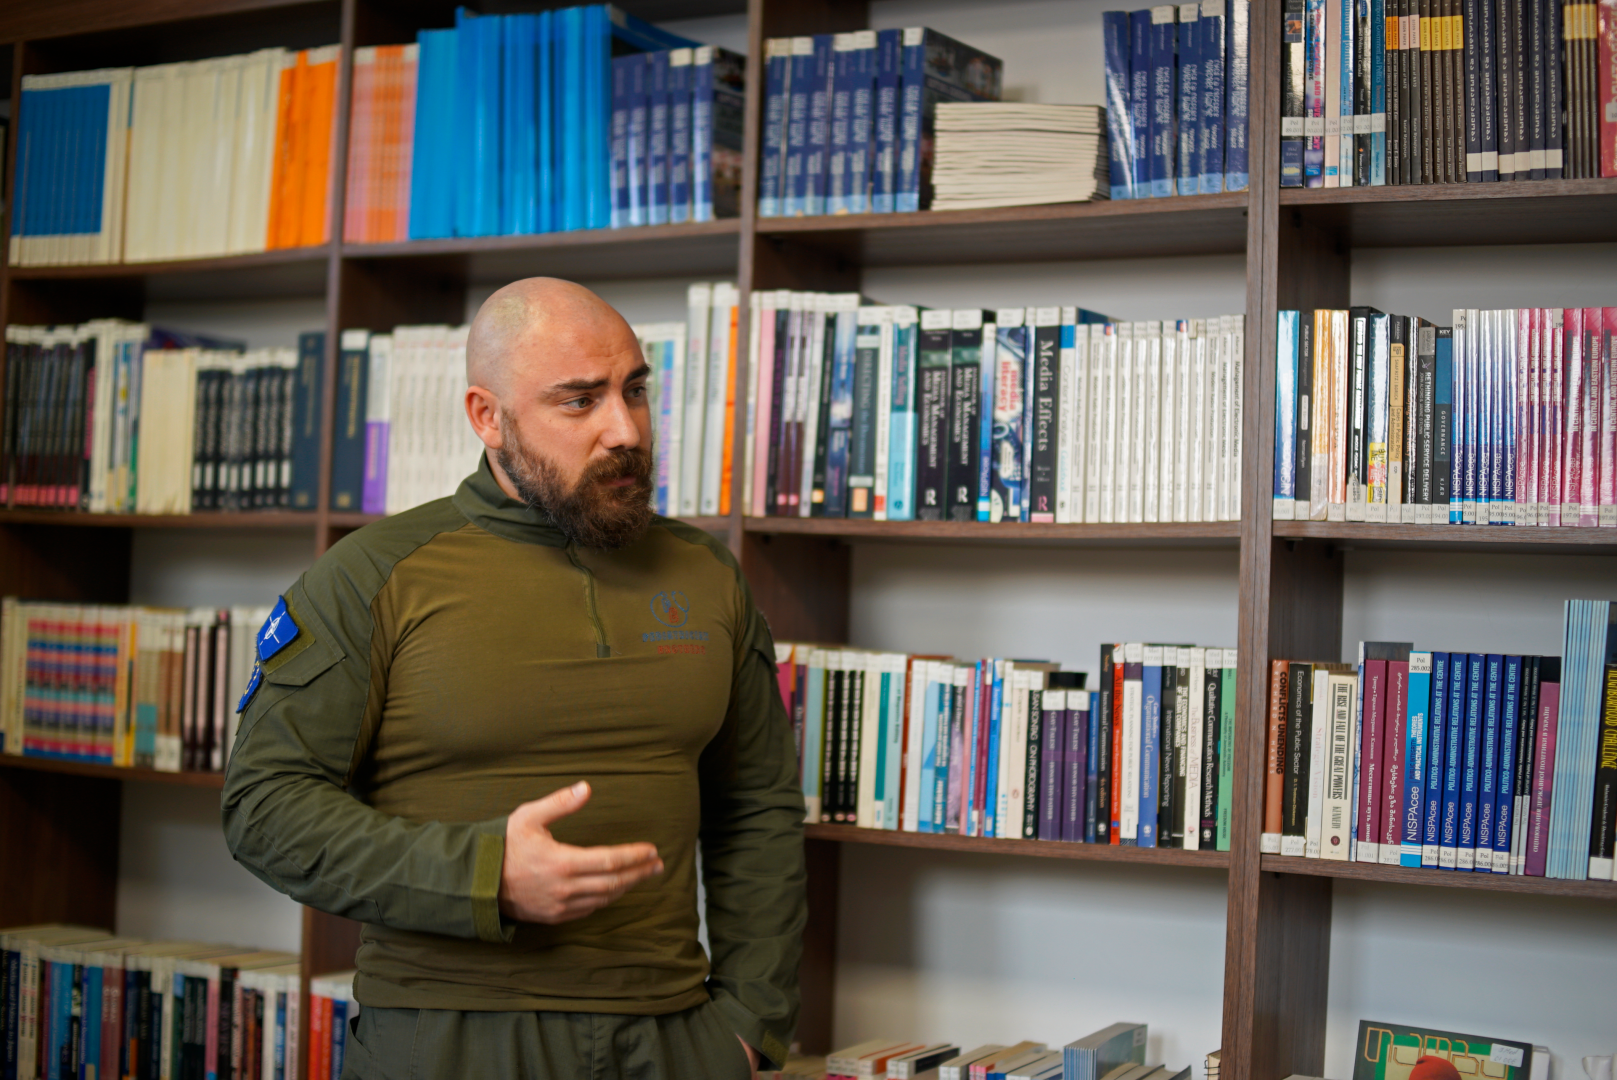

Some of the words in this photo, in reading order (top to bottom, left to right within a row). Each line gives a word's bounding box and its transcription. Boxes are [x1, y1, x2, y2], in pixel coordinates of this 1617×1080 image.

[860, 350, 872, 408] DIRECTING
[932, 371, 941, 401] MEDIA
[1039, 341, 1054, 391] Media
[1062, 365, 1071, 405] Content
[895, 377, 907, 405] Selling
[998, 361, 1010, 412] literacy
[1010, 370, 1019, 410] media
[922, 393, 932, 446] ECONOMICS
[954, 390, 963, 442] ECONOMICS
[960, 401, 971, 466] MANAGEMENT
[1038, 398, 1053, 451] Effects
[928, 404, 940, 469] MANAGEMENT
[1370, 451, 1378, 461] ME
[1453, 452, 1461, 496] NISPAcee
[1466, 453, 1475, 496] NISPAcee
[1479, 453, 1488, 496] NISPAcee
[1492, 453, 1501, 496] NISPAcee
[1505, 453, 1514, 496] NISPAcee
[925, 489, 936, 506] R
[957, 487, 968, 503] R
[669, 607, 679, 623] B
[658, 644, 706, 655] BROTHERS
[1207, 683, 1217, 714] Qualitative
[1278, 672, 1287, 721] CONFLICTS
[1296, 671, 1304, 708] Economics
[1336, 696, 1347, 707] RISE
[1337, 684, 1348, 692] THE
[1030, 712, 1039, 740] SONTAG
[1145, 696, 1153, 744] Organizational
[1165, 710, 1173, 750] International
[1335, 721, 1346, 733] FALL
[1336, 709, 1346, 719] AND
[1434, 698, 1442, 724] RELATIONS
[1451, 699, 1459, 725] RELATIONS
[1487, 700, 1496, 726] RELATIONS
[1505, 702, 1514, 728] RELATIONS
[1030, 745, 1038, 758] ON
[1190, 718, 1199, 747] Business
[1206, 716, 1215, 760] Communication
[1276, 724, 1285, 775] UNENDING
[1313, 728, 1323, 768] Strategic
[1334, 744, 1345, 754] THE
[1601, 729, 1617, 769] CHALLENGE
[1142, 745, 1153, 798] Communication
[1189, 758, 1198, 789] MEDIA
[1205, 762, 1214, 789] Research
[1334, 756, 1344, 772] GREAT
[1430, 726, 1440, 789] POLITICO-ADMINISTRATIVE
[1448, 727, 1458, 790] POLITICO-ADMINISTRATIVE
[1484, 728, 1494, 792] POLITICO-ADMINISTRATIVE
[1502, 729, 1512, 793] POLITICO-ADMINISTRATIVE
[1027, 759, 1037, 811] PHOTOGRAPHY
[1162, 774, 1170, 807] Reporting
[1204, 791, 1212, 817] Methods
[1313, 772, 1322, 798] Vision
[1332, 775, 1343, 799] POWERS
[1536, 771, 1545, 808] ДЕРЖАВНОЇ
[1332, 806, 1342, 829] KENNEDY
[1407, 786, 1419, 841] NISPAcee
[1427, 800, 1437, 841] NISPAcee
[1444, 802, 1454, 843] NISPAcee
[1462, 803, 1472, 844] NISPAcee
[1481, 804, 1490, 844] NISPAcee
[1498, 805, 1508, 846] NISPAcee
[1532, 809, 1541, 852] ОЦІНЮВАННЯ
